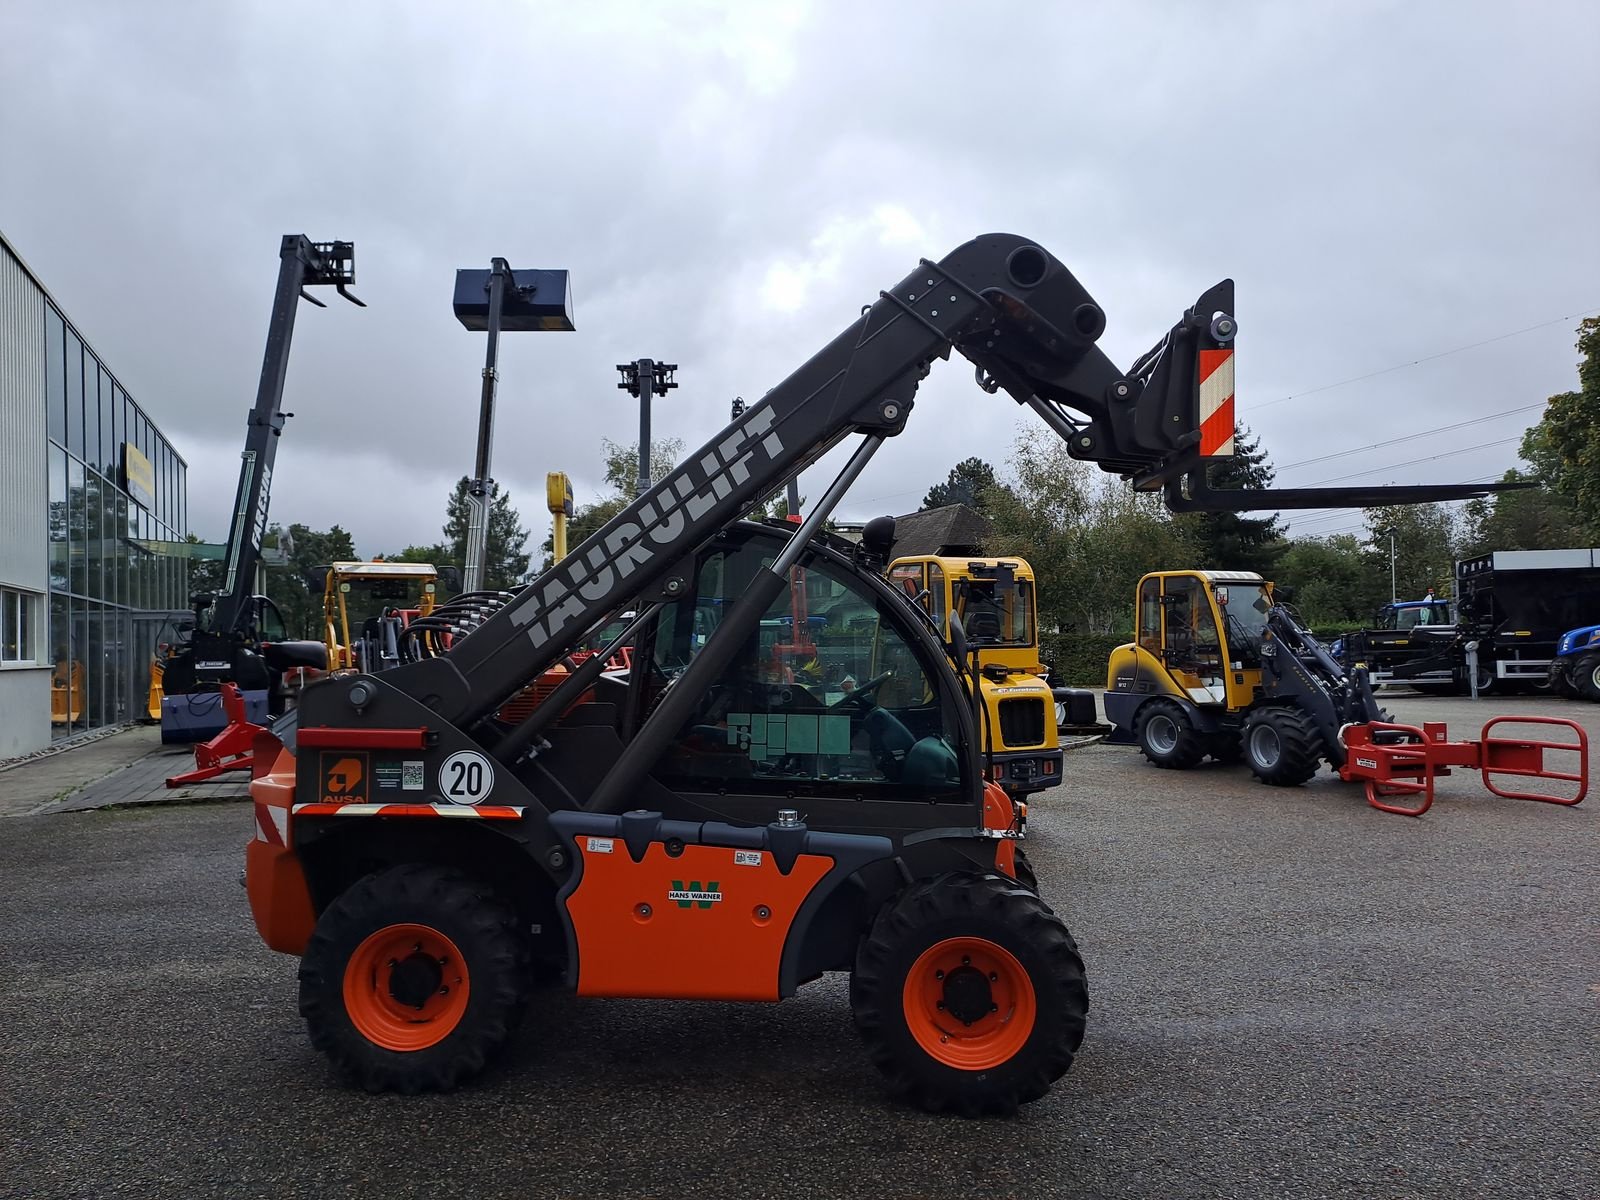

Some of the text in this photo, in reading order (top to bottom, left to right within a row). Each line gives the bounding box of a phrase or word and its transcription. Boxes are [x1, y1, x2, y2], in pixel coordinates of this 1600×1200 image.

[251, 463, 271, 552] FARESIN
[508, 404, 784, 649] TAURULIFT
[323, 795, 365, 803] AUSA
[450, 761, 482, 796] 20
